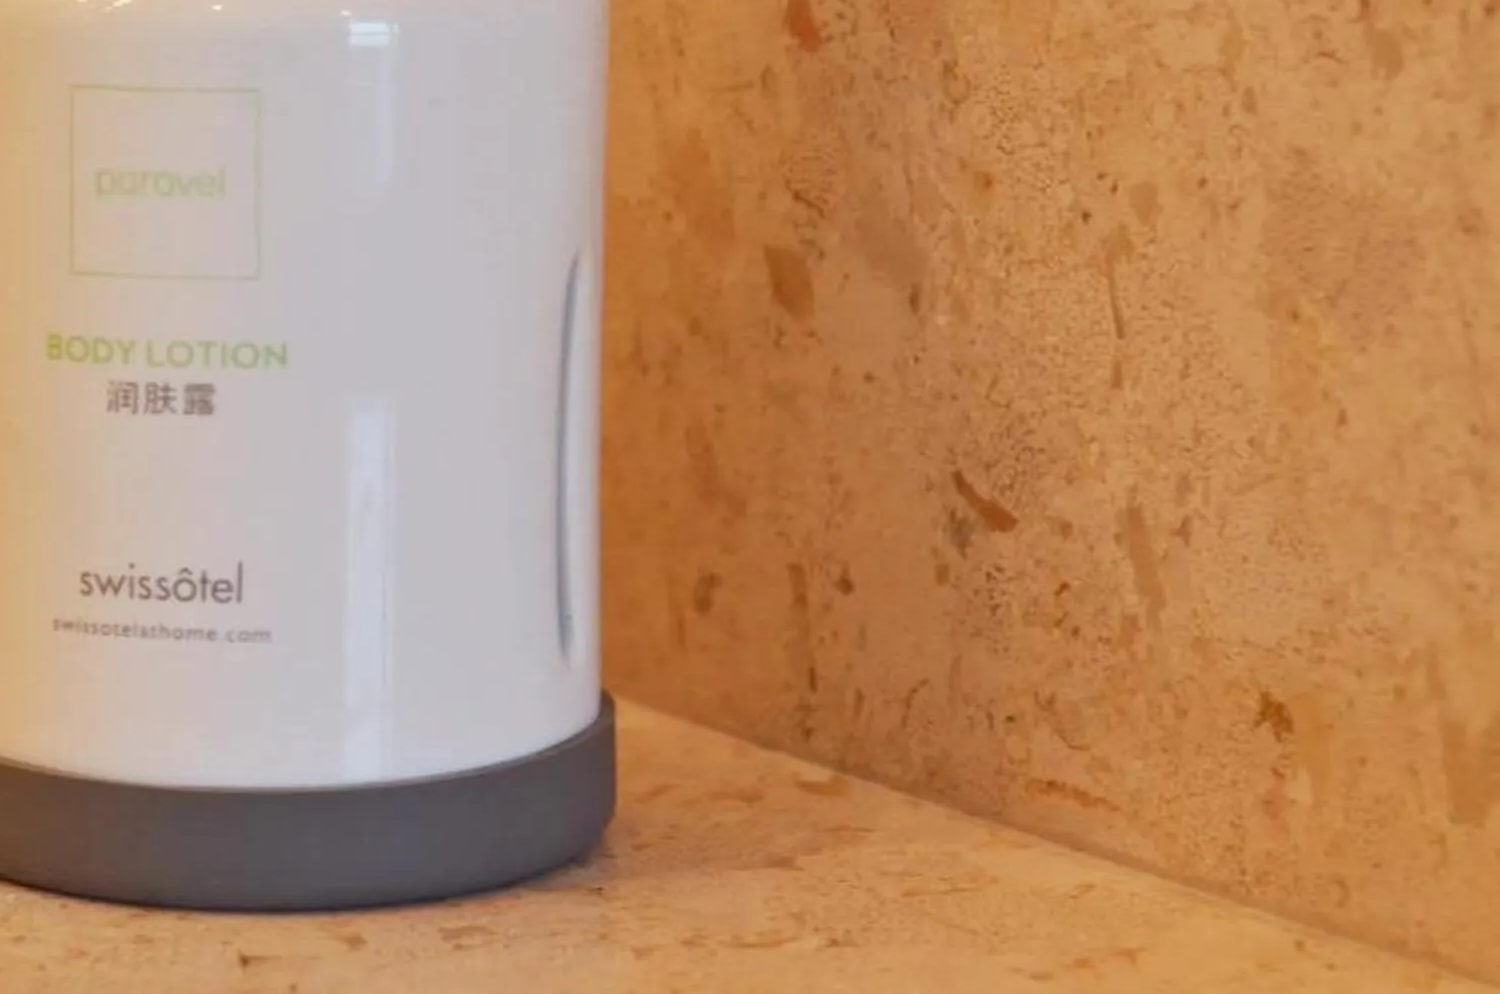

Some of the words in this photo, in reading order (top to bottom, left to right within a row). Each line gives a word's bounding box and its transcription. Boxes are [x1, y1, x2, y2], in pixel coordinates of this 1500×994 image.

[45, 333, 137, 365] BODY
[145, 339, 288, 370] LOTION
[105, 379, 217, 416] 润肤露
[78, 559, 244, 605] swissôtel
